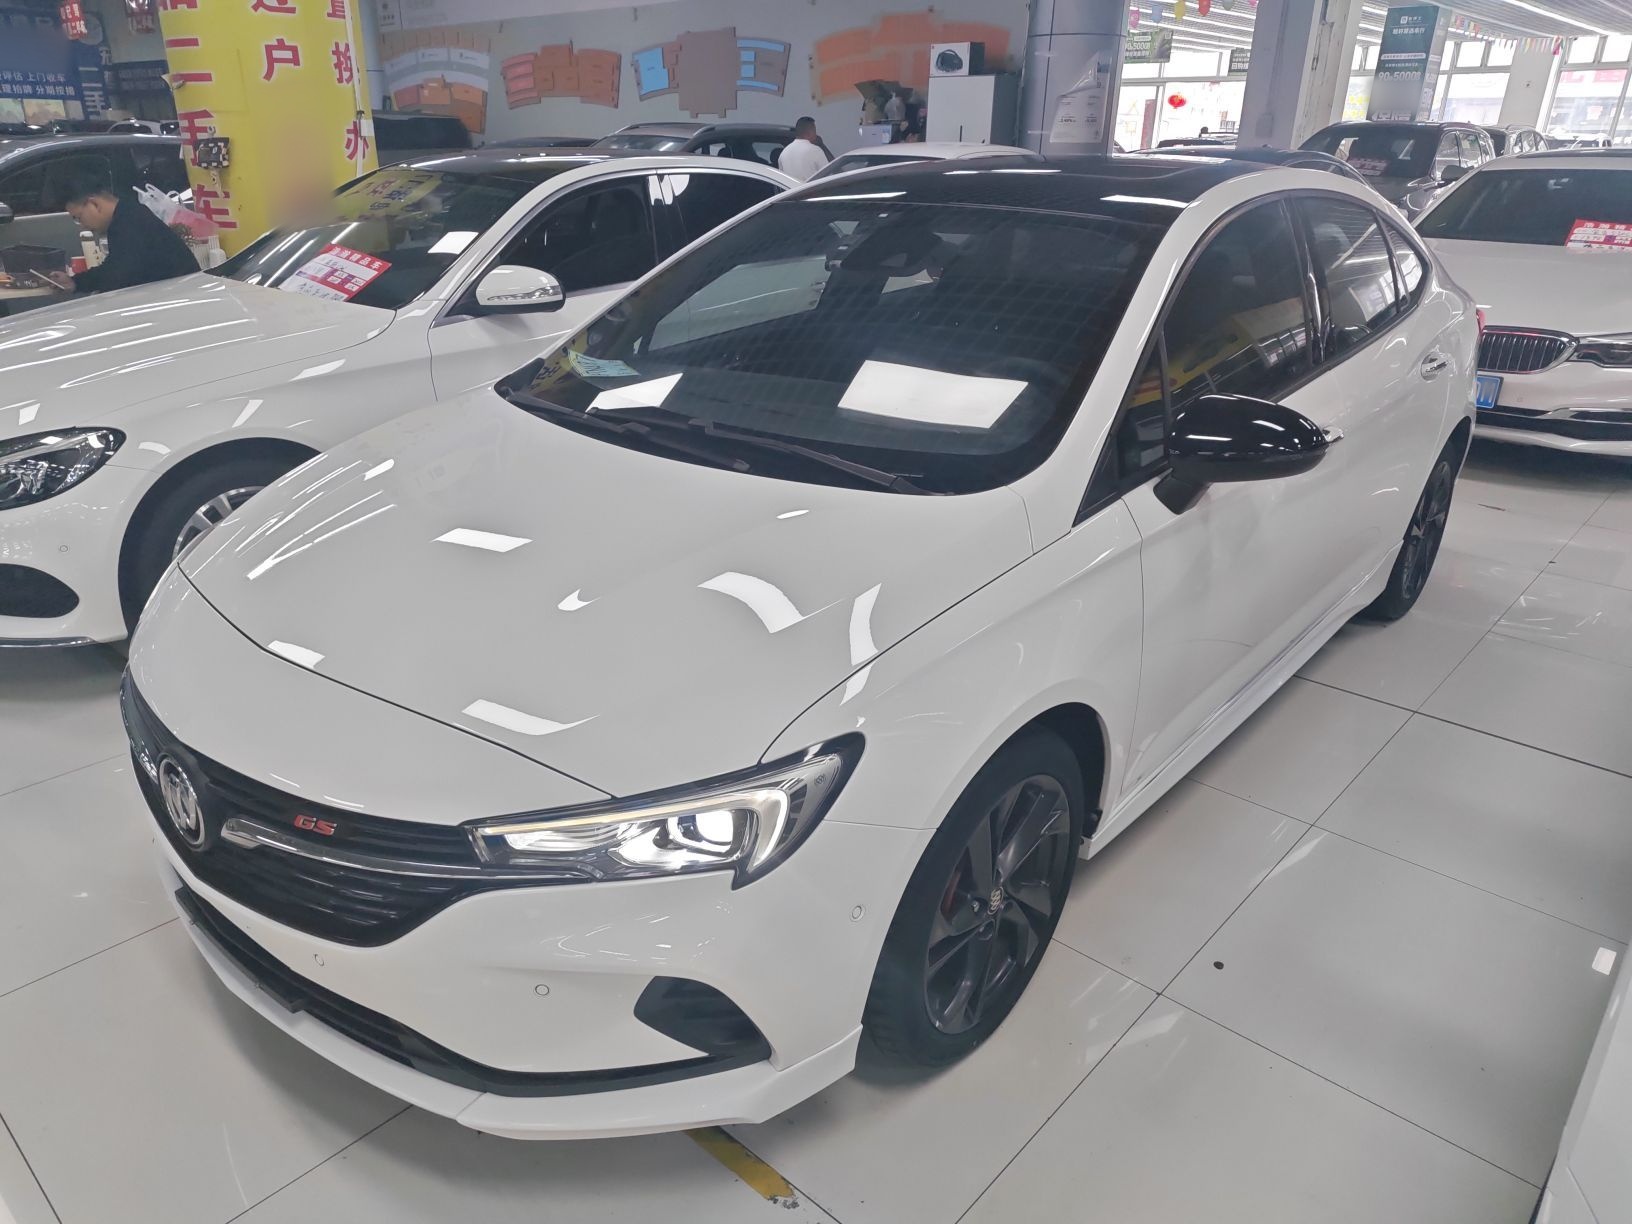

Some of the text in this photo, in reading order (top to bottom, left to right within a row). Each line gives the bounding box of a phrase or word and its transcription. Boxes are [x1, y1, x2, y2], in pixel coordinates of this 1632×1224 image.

[0, 71, 23, 83] 评估
[0, 84, 34, 95] 理拍牌
[157, 0, 238, 240] 二手车
[293, 814, 338, 836] GS
